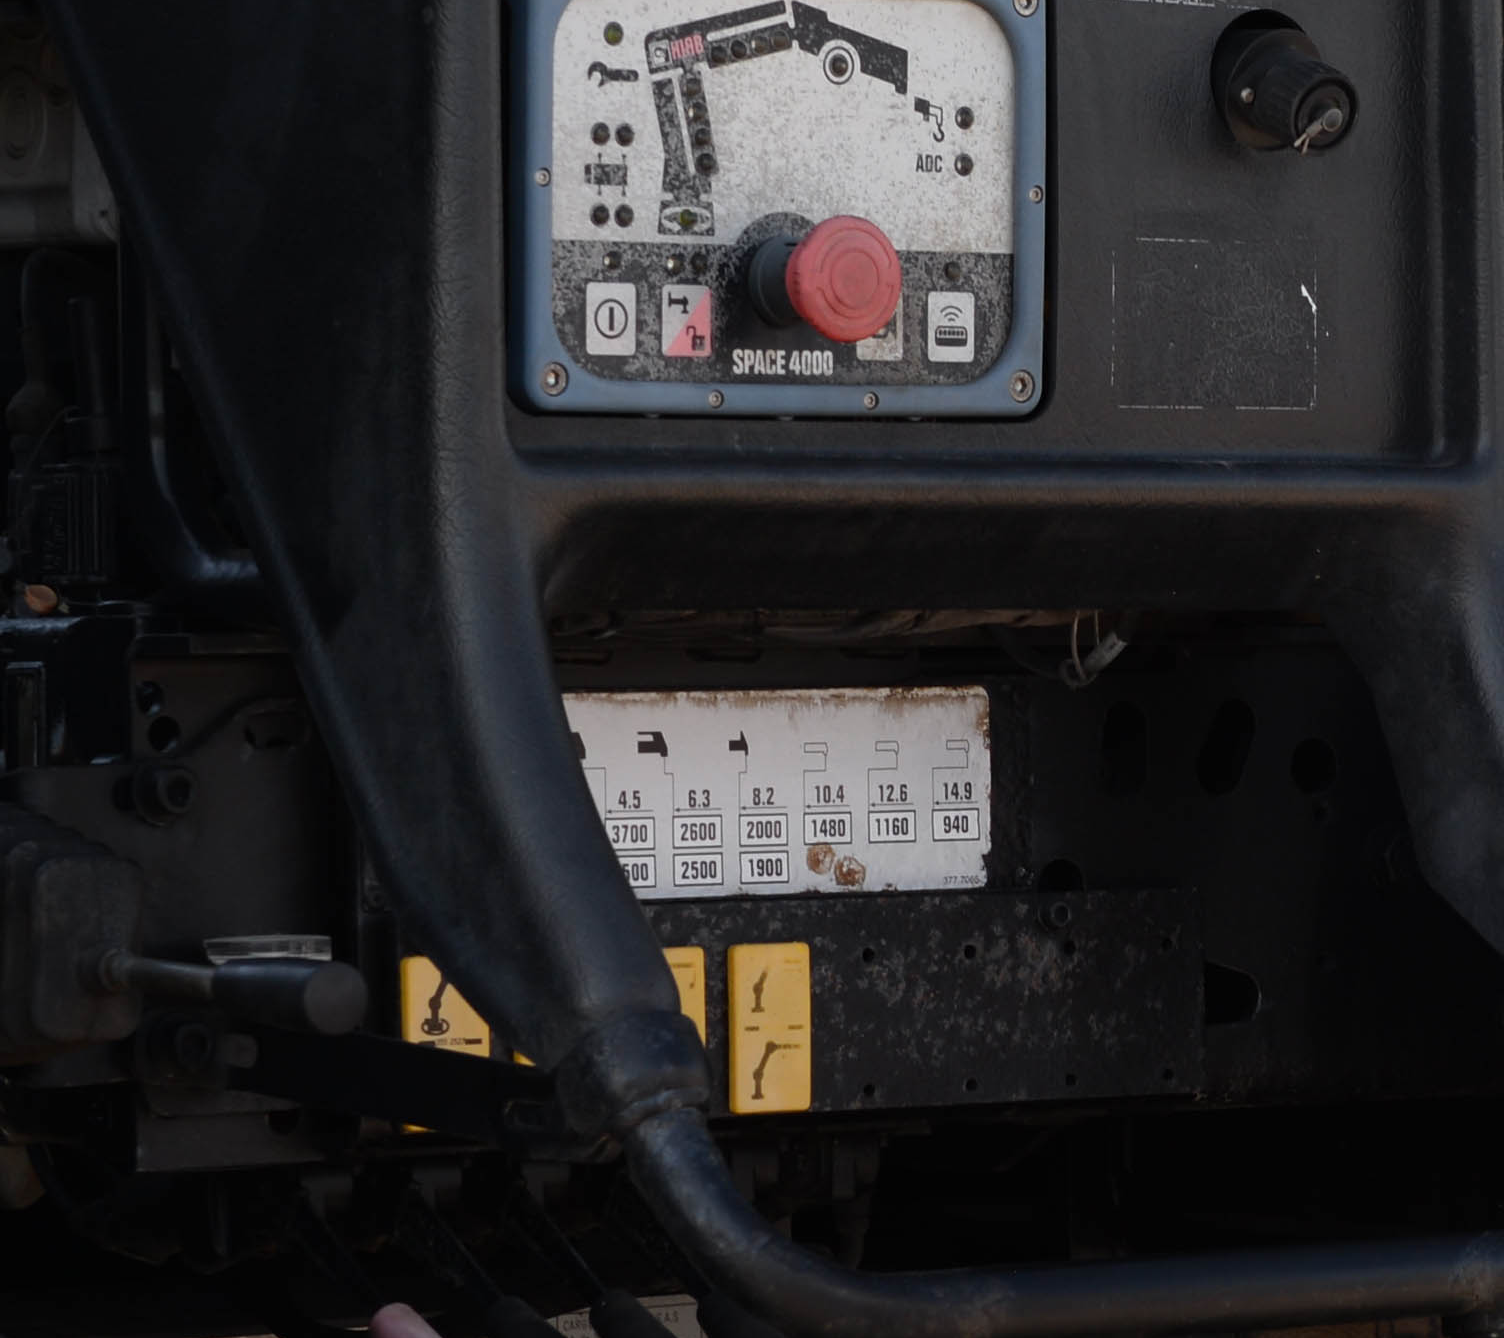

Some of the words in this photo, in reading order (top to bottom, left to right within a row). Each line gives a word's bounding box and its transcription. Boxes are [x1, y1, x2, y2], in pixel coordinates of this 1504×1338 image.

[671, 32, 705, 60] HIAB
[915, 153, 943, 174] ADC
[732, 348, 785, 376] SPACE
[788, 349, 834, 377] 4000
[618, 789, 641, 809] 4.5
[688, 788, 711, 808] 6.3
[752, 786, 775, 806] 8.2
[814, 784, 845, 803] 10.4
[878, 783, 908, 803] 12.6
[943, 781, 973, 801] 14.9
[612, 823, 648, 844] 3700
[680, 822, 716, 842] 2600
[747, 820, 782, 839] 2000
[811, 818, 846, 838] 1480
[875, 817, 909, 836] 1160
[943, 814, 969, 834] 940
[621, 862, 649, 882] 500
[681, 860, 717, 880] 2500
[748, 857, 784, 878] 1900
